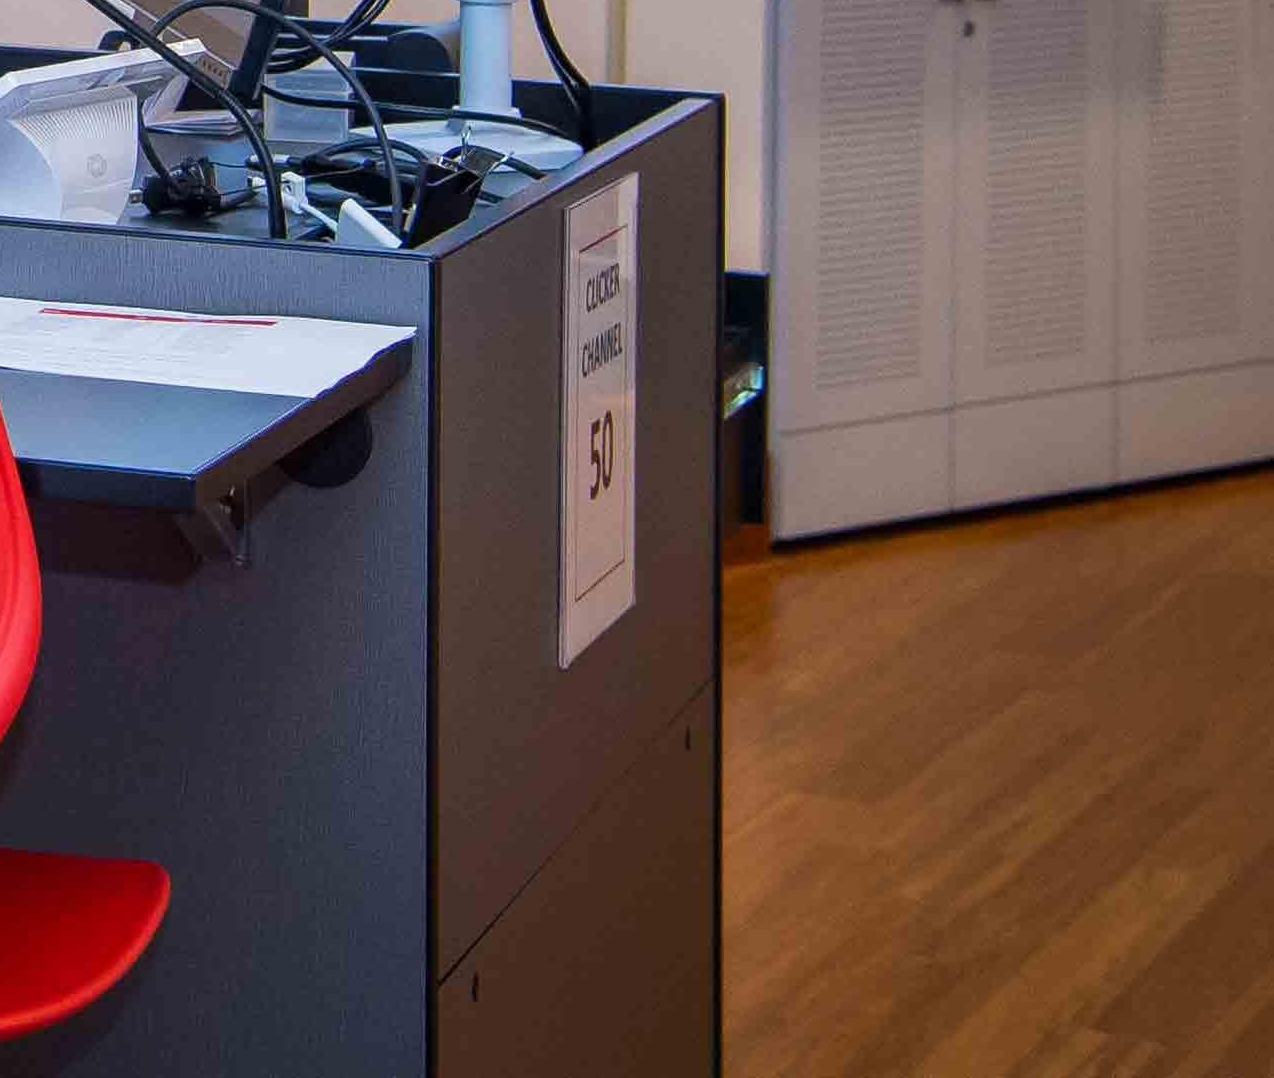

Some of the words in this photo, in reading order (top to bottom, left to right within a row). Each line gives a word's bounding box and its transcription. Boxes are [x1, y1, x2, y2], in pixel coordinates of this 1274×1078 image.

[586, 263, 620, 313] CLICKER
[582, 322, 623, 378] CHANNEL
[590, 410, 614, 500] 50
